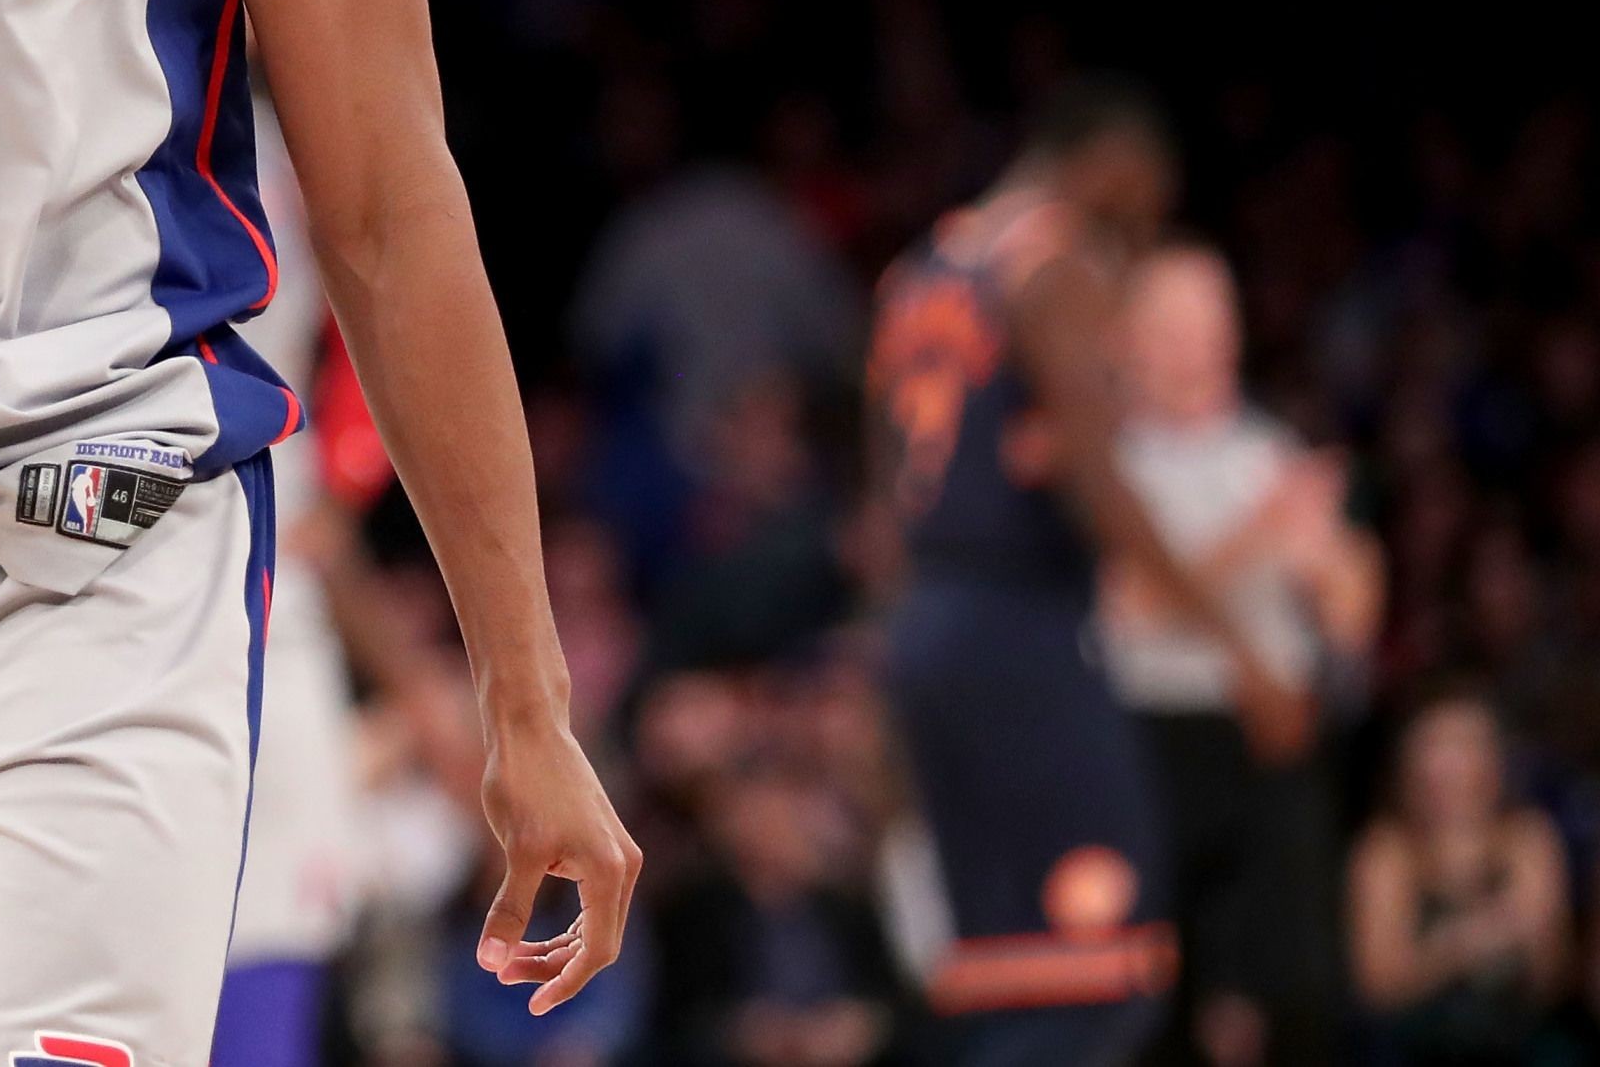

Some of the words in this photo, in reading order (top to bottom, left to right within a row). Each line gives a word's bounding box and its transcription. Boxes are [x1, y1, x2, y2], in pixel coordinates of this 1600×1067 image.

[75, 442, 148, 461] DETROIT
[149, 448, 184, 469] BAS
[111, 488, 129, 504] 46
